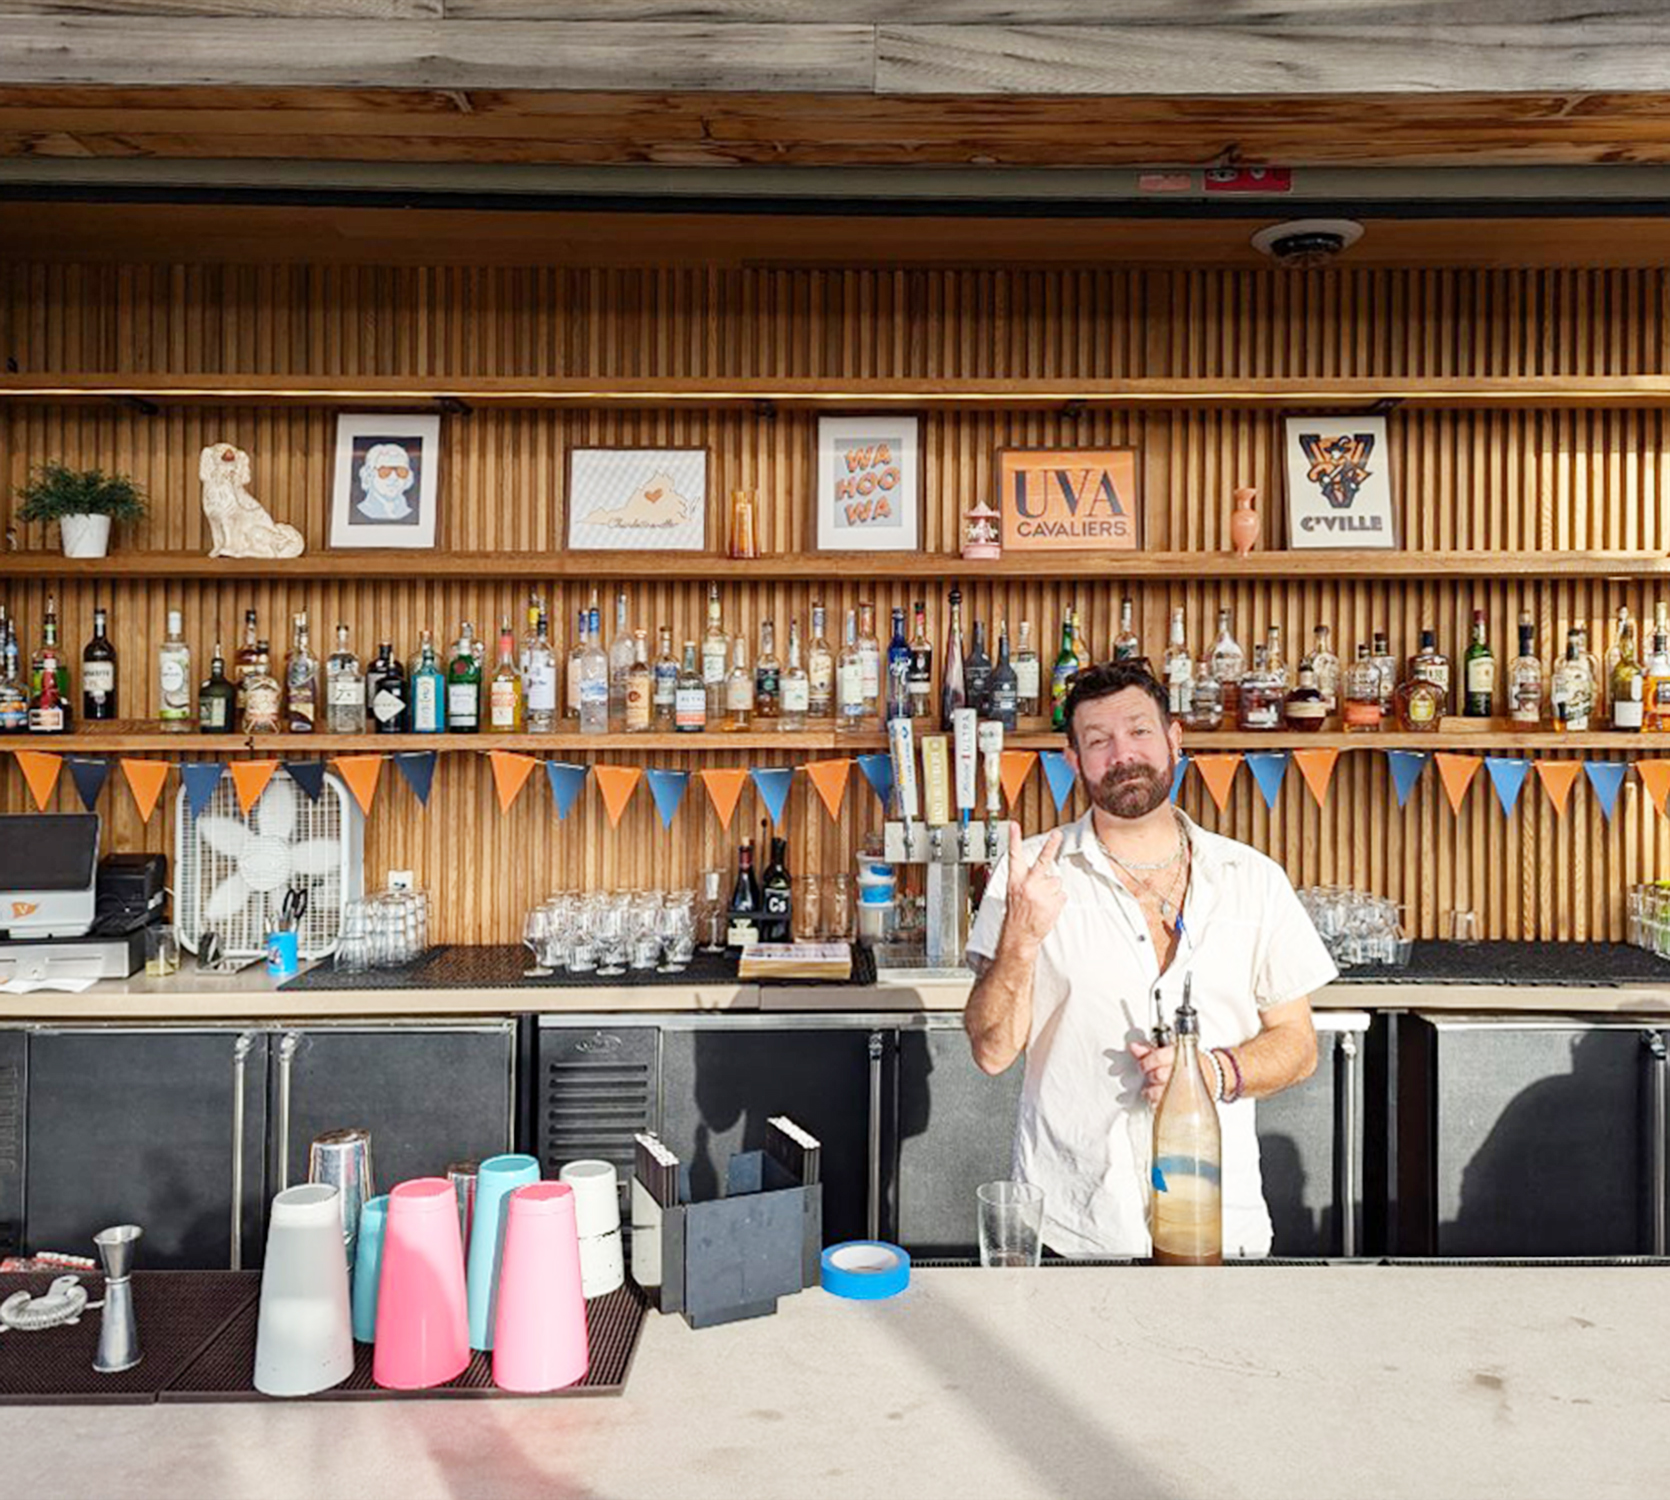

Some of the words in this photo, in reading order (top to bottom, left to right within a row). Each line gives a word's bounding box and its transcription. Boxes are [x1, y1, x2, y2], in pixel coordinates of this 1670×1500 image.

[844, 443, 892, 472] WA
[835, 467, 901, 501] HOO
[1012, 468, 1130, 519] UVA
[844, 496, 892, 526] WA
[962, 714, 971, 752] ULTRA
[768, 896, 787, 913] Cs
